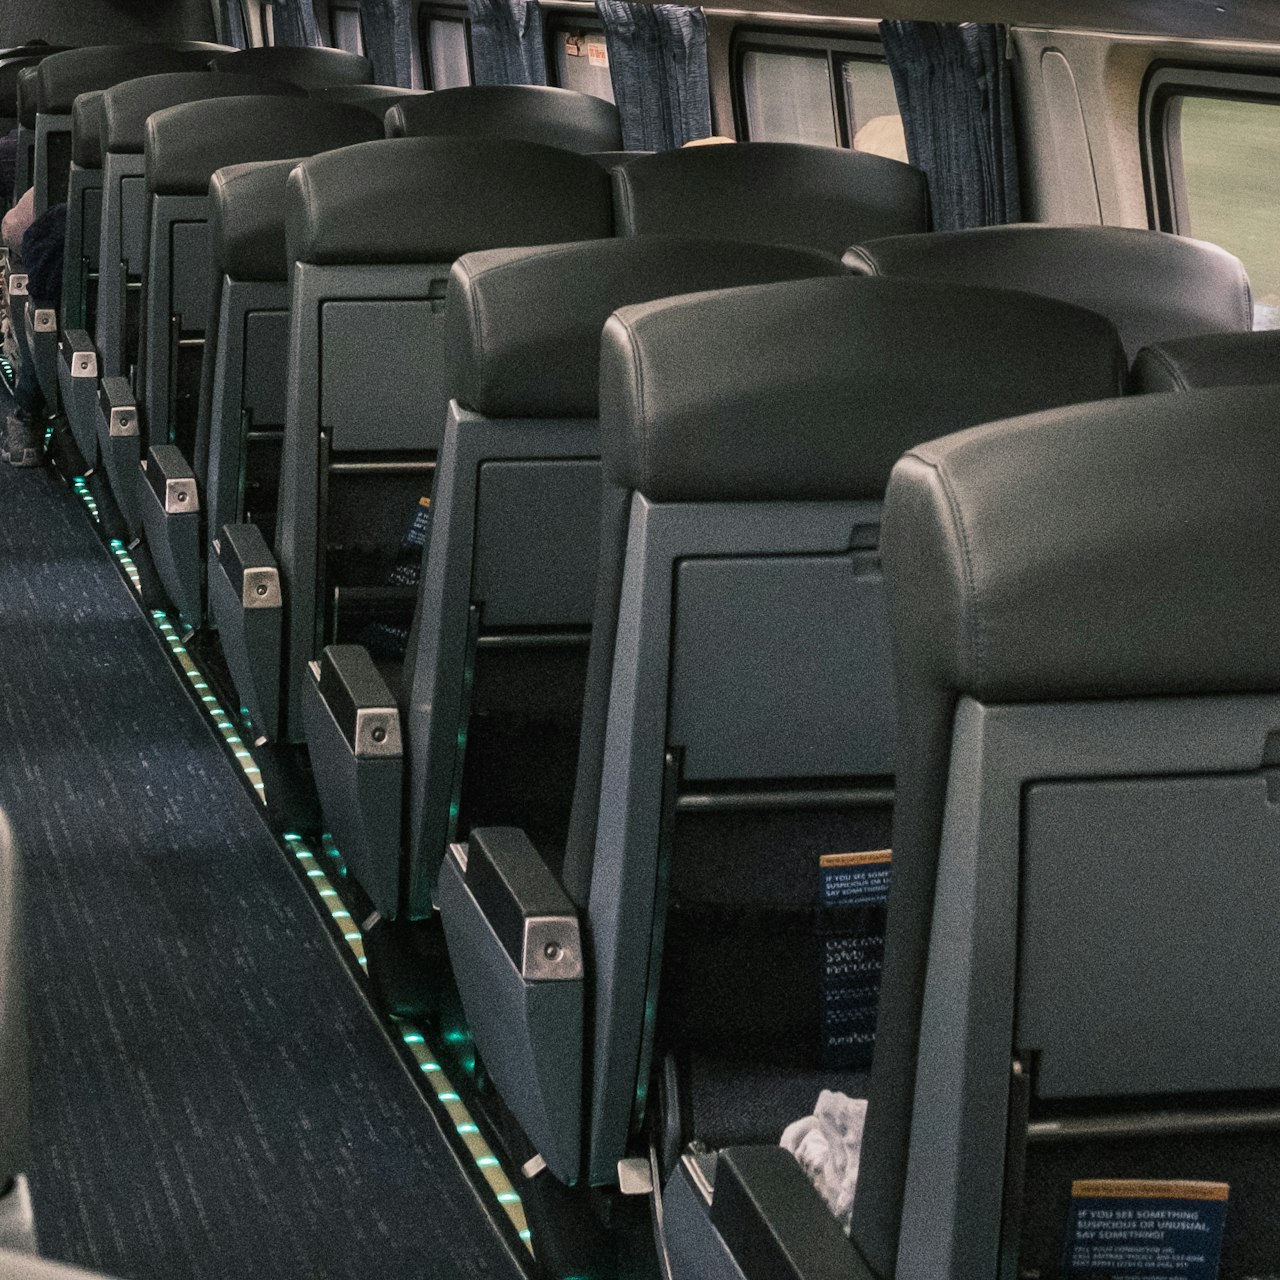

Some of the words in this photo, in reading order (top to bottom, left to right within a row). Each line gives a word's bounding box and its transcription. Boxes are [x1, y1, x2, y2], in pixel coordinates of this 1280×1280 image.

[1090, 1210, 1113, 1219] YOU
[1136, 1211, 1199, 1220] SOMETHING
[1077, 1220, 1137, 1230] SUSPICIOUS
[1139, 1221, 1155, 1229] OR
[1076, 1230, 1094, 1239] SAY
